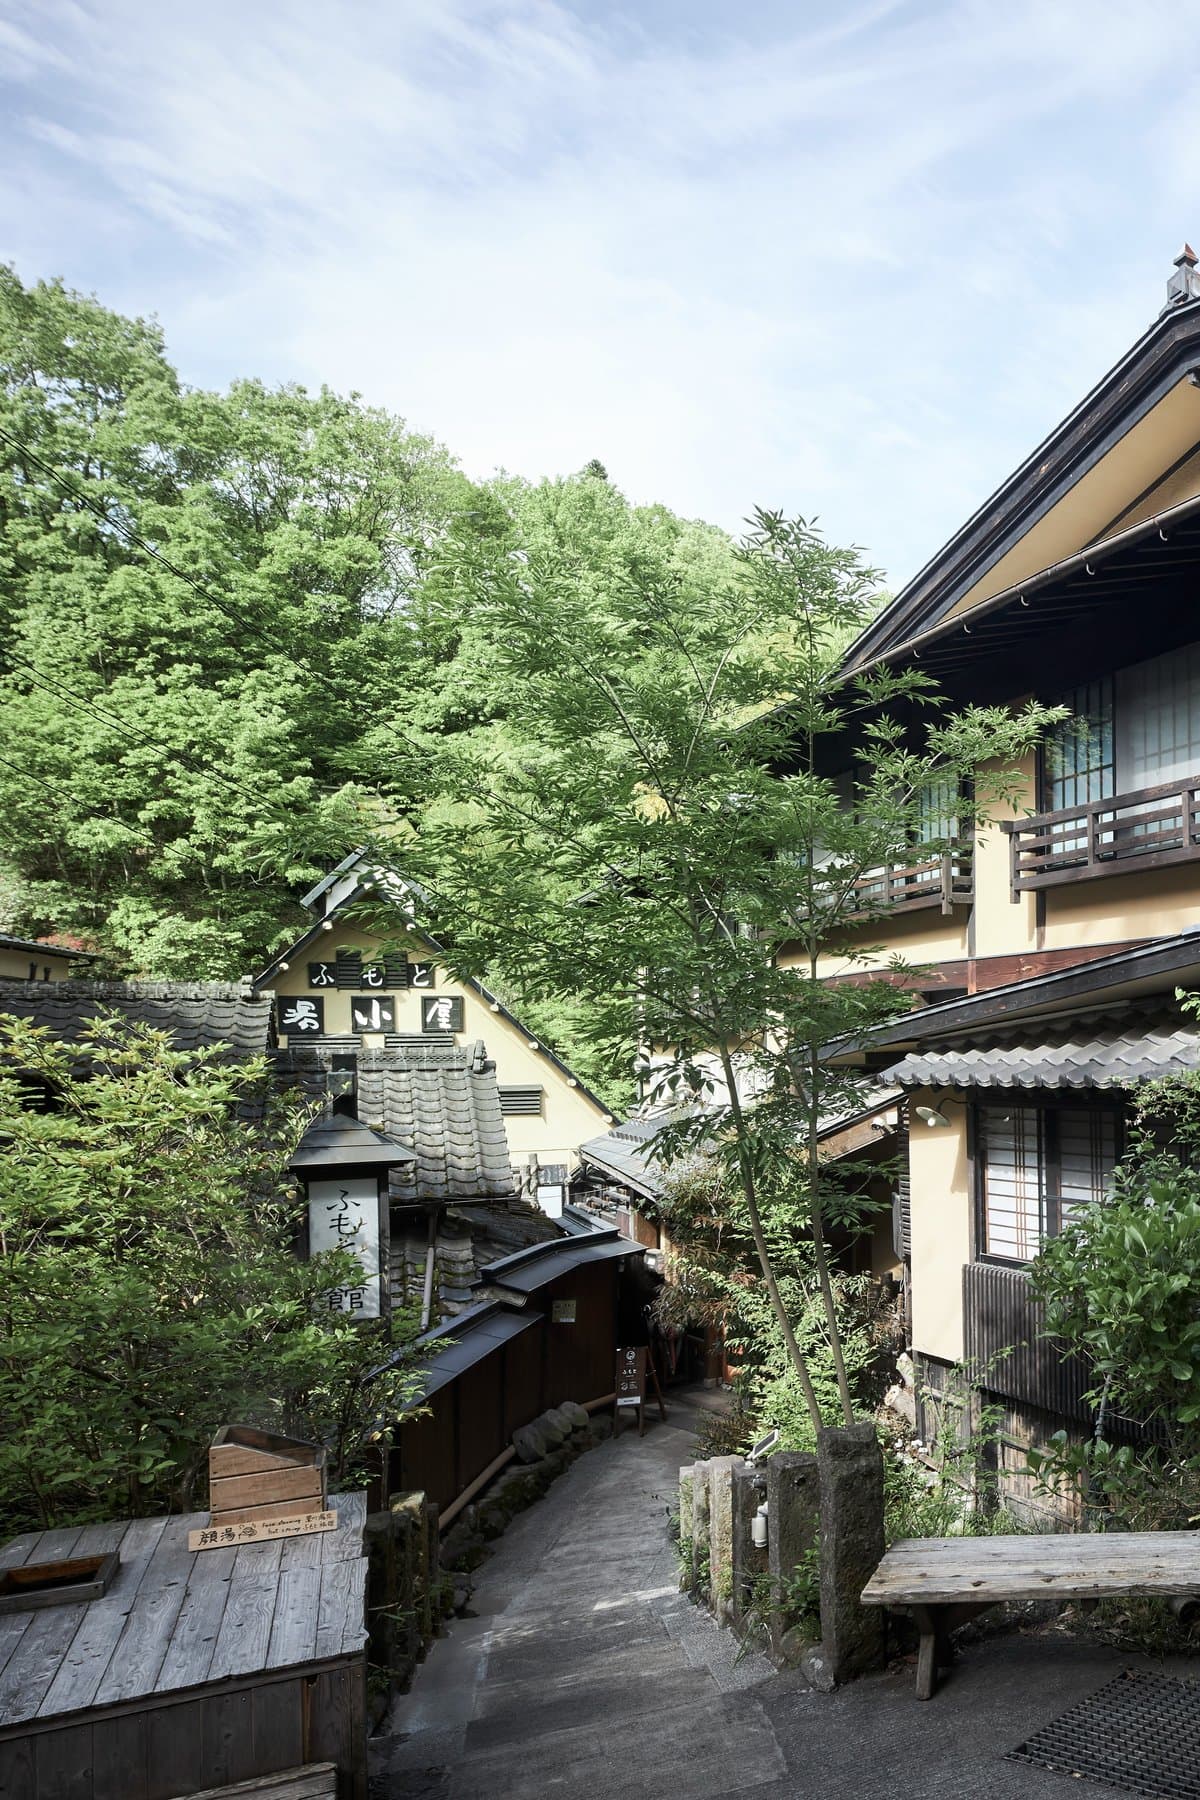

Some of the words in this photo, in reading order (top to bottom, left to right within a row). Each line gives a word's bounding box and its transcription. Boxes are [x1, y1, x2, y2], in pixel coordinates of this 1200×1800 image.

[311, 964, 430, 987] ふもと
[198, 1527, 236, 1545] 顔湯
